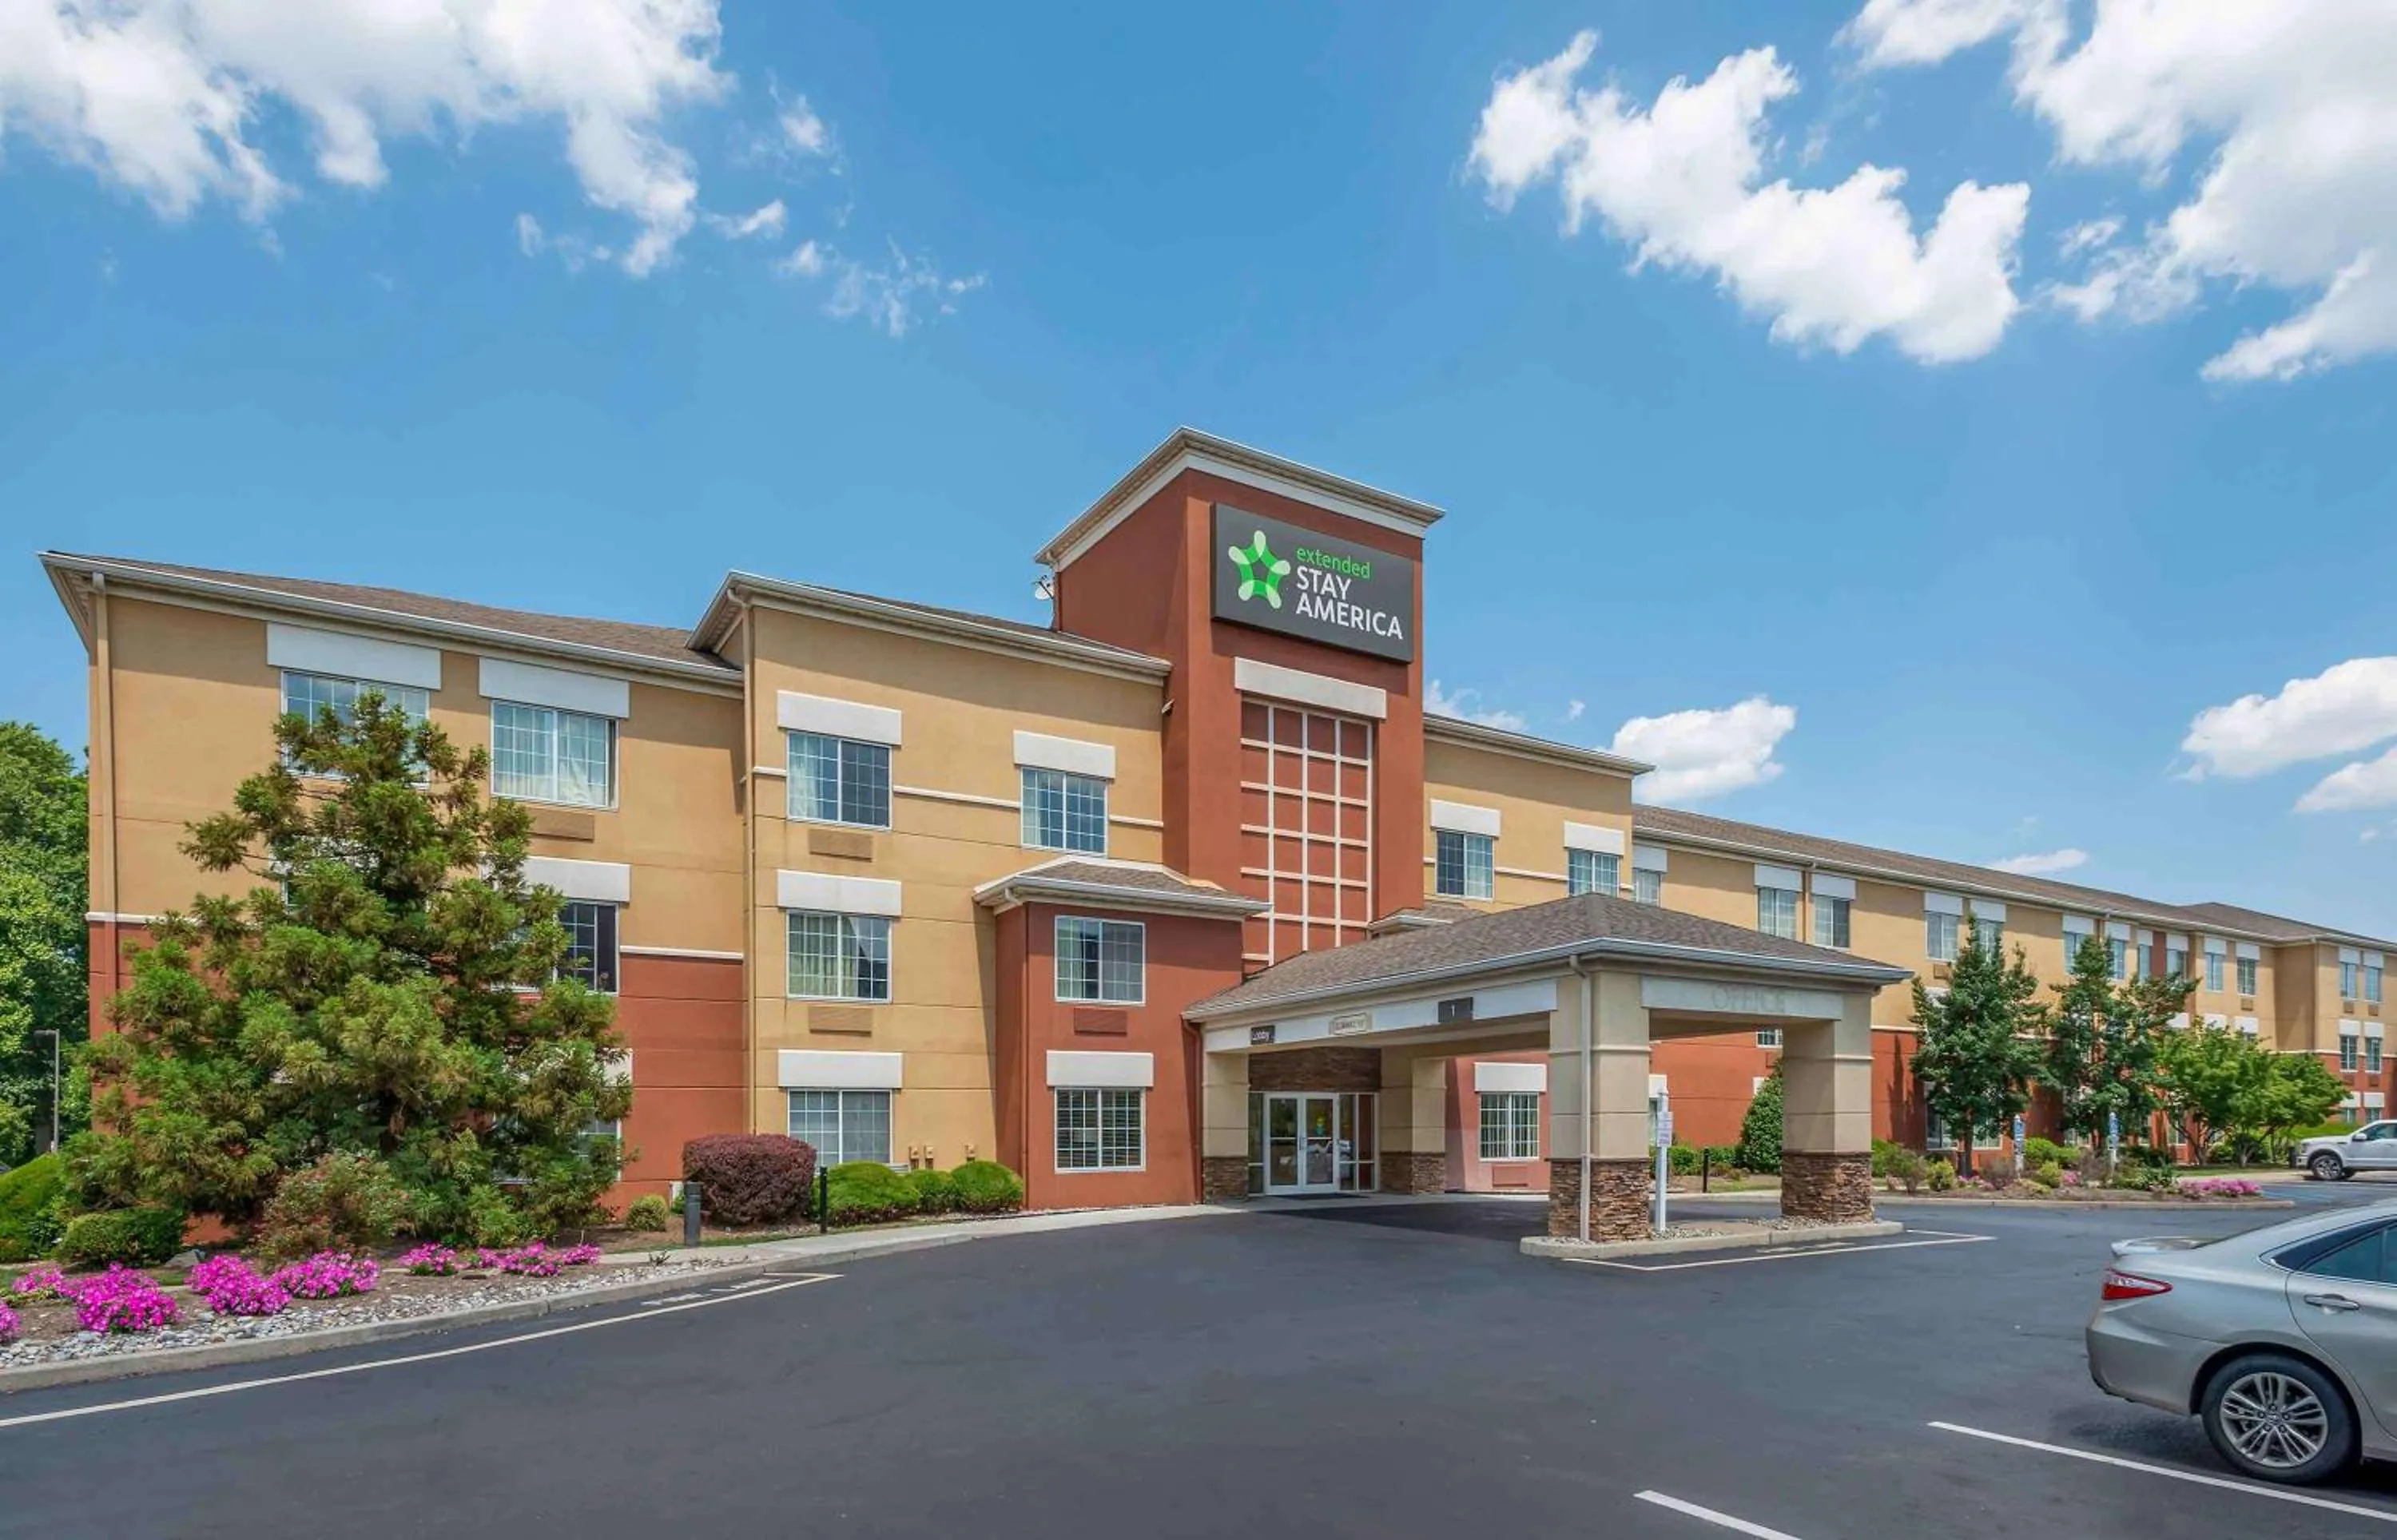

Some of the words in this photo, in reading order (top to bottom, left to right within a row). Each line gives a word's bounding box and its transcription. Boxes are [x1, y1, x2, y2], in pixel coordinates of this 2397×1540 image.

[1297, 547, 1370, 579] extended
[1296, 566, 1351, 600] STAY
[1295, 593, 1403, 640] AMERICA
